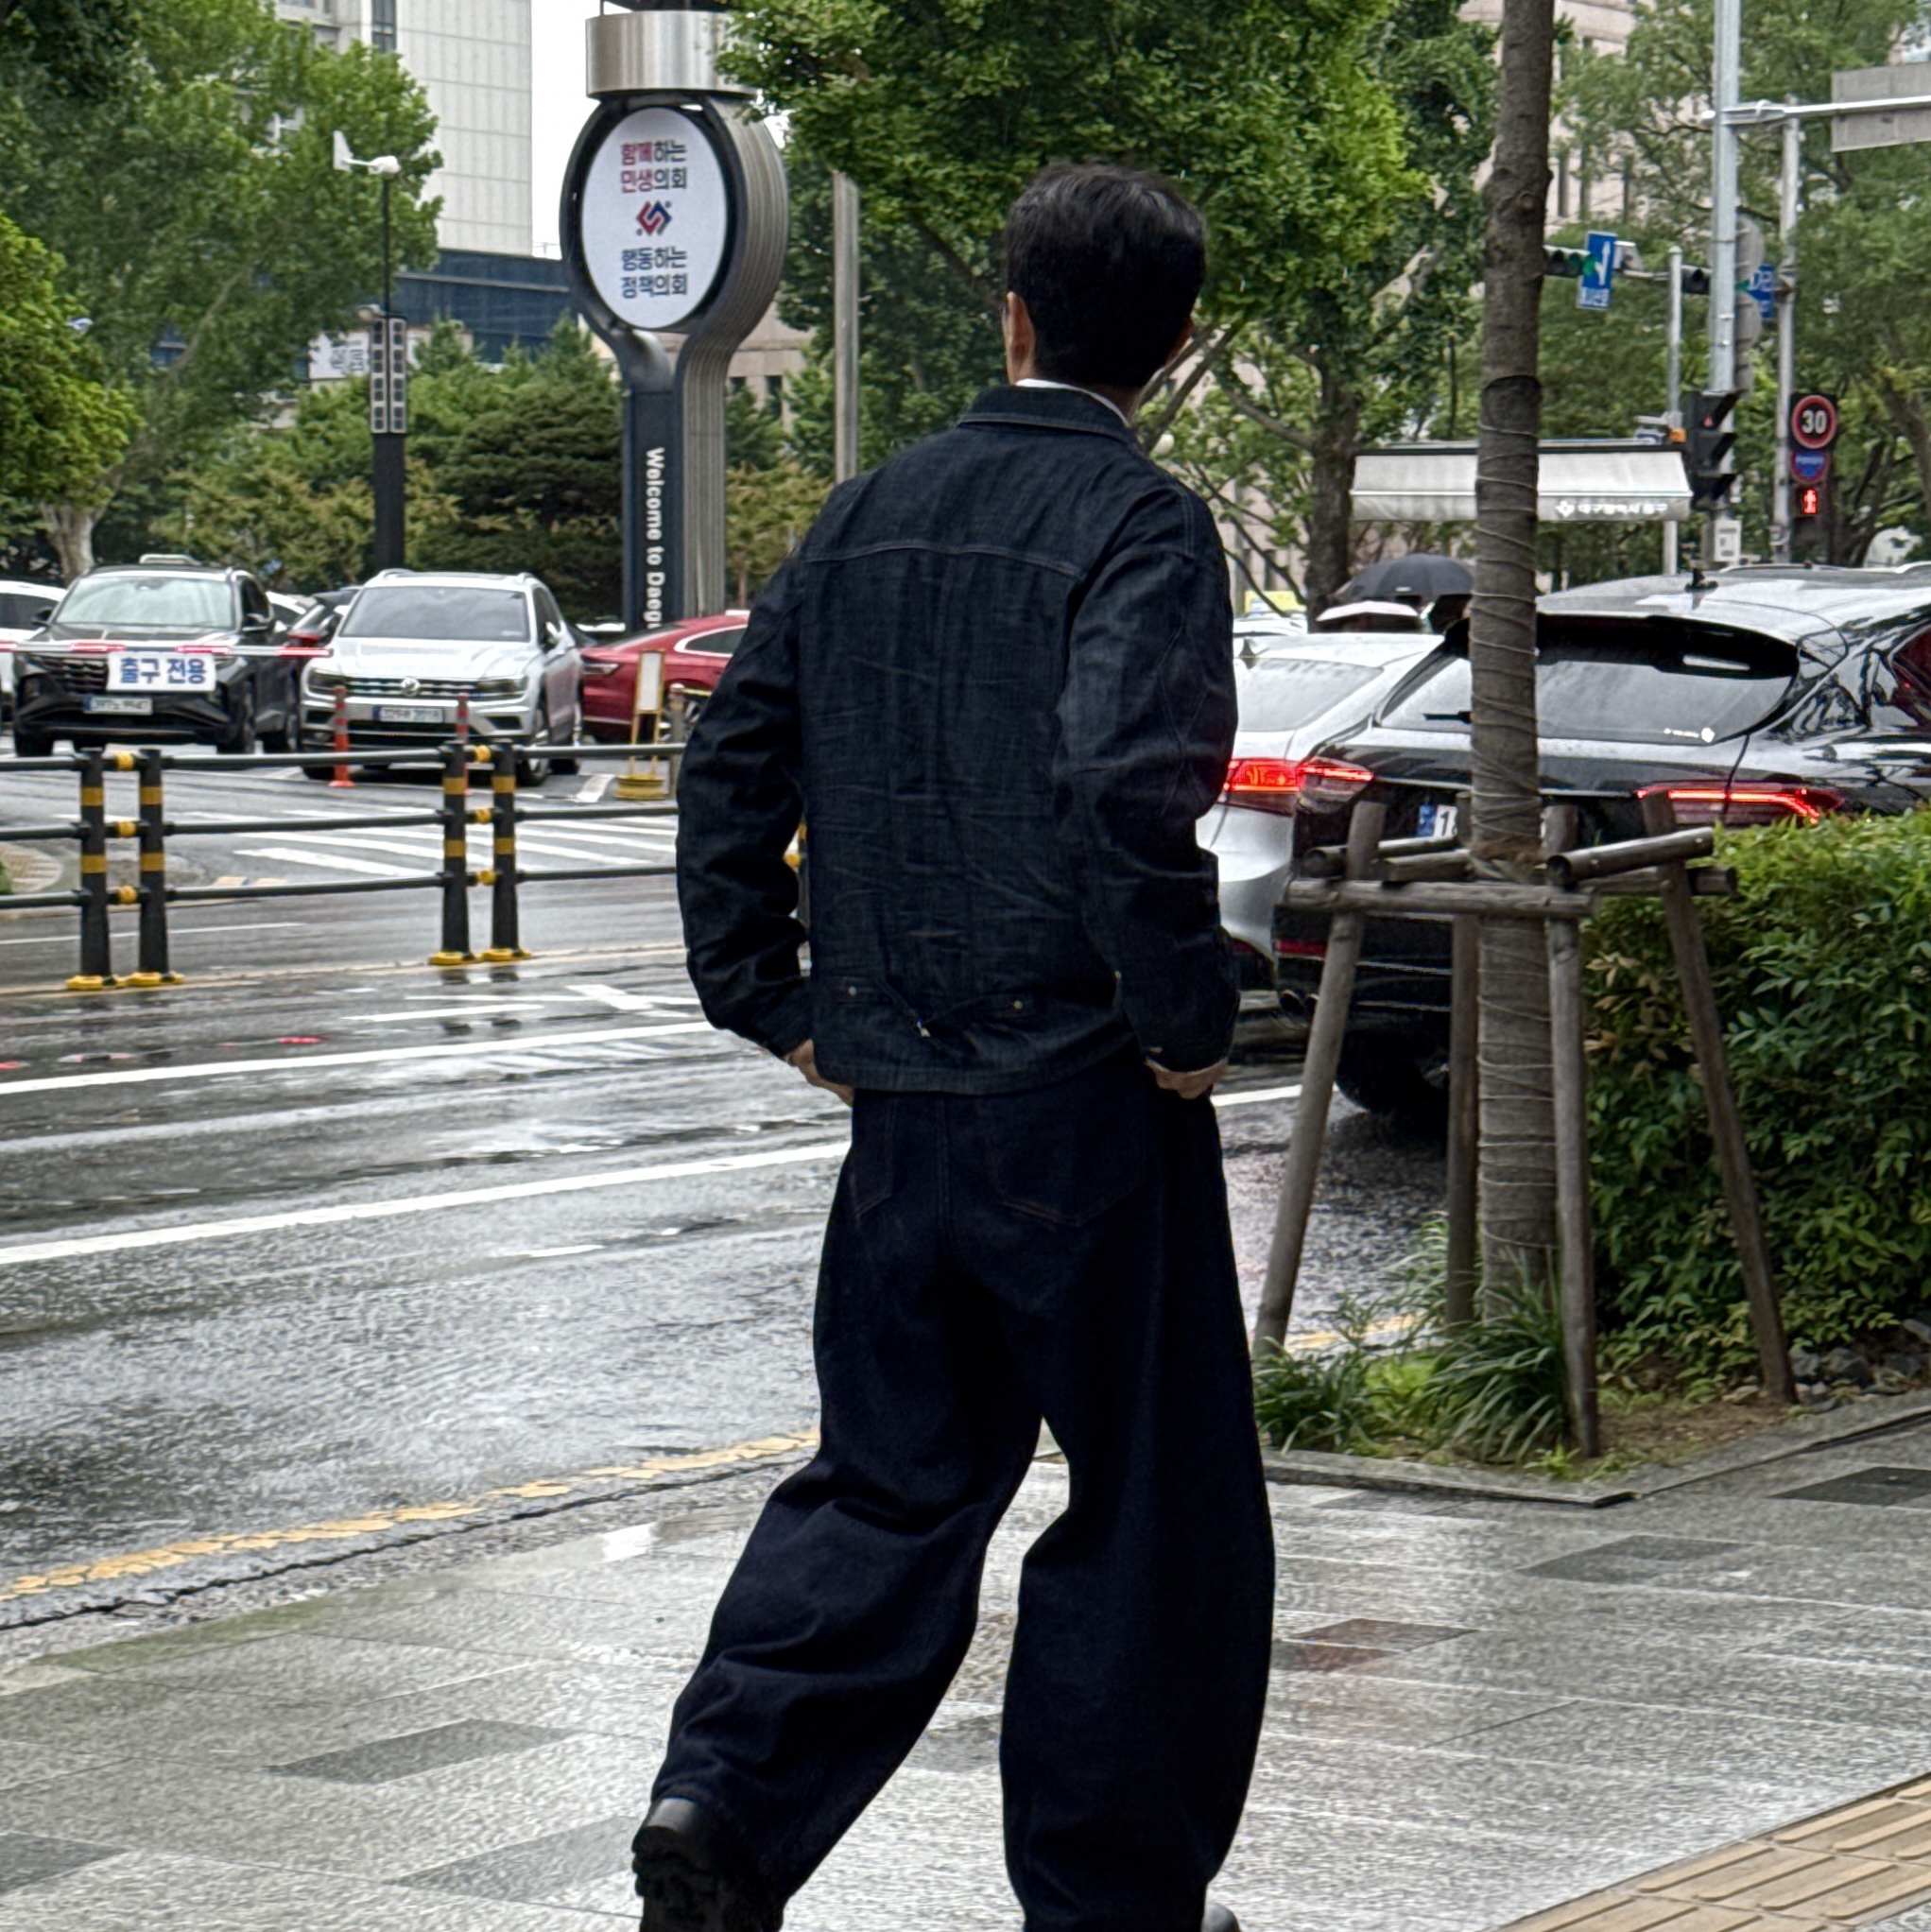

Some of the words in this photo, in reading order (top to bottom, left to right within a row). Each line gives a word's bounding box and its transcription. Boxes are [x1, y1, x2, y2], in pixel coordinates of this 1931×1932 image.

[621, 139, 688, 165] 함께하는
[621, 166, 688, 194] 민생의회
[621, 246, 688, 271] 행동하는
[620, 272, 688, 299] 정책의회
[1802, 409, 1828, 435] 30
[645, 446, 665, 541] Welcome
[646, 545, 665, 566] to
[120, 656, 161, 684] 출구
[166, 657, 206, 684] 전용
